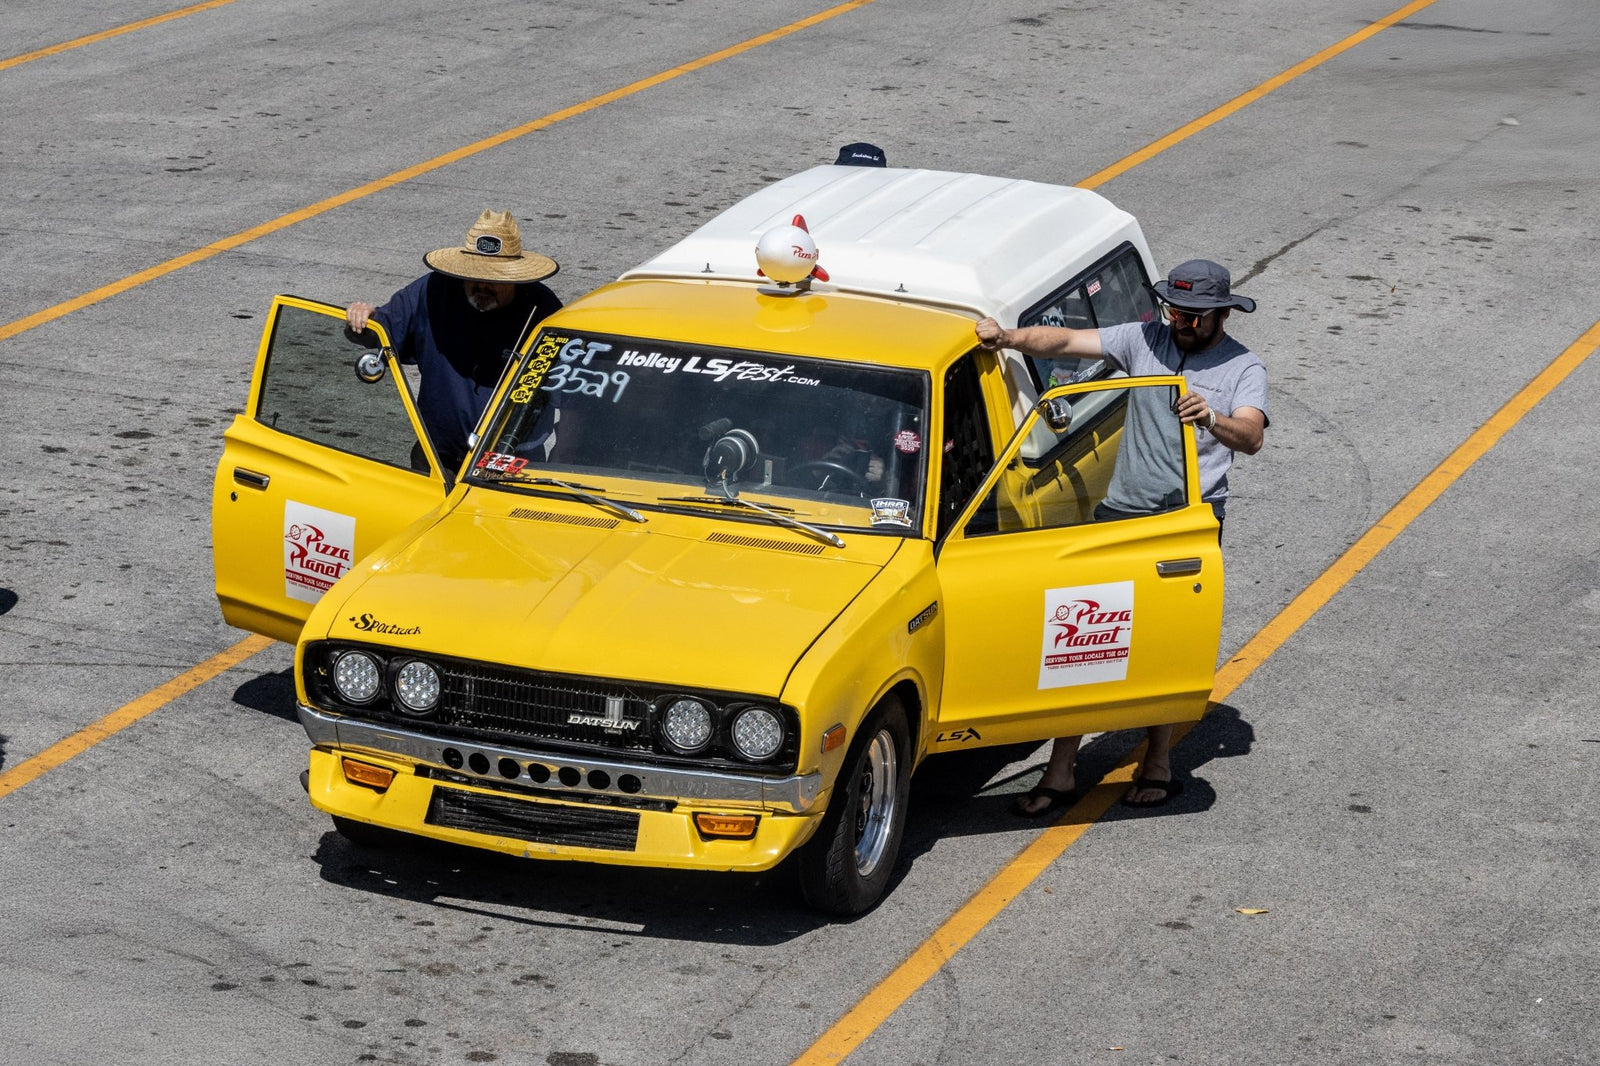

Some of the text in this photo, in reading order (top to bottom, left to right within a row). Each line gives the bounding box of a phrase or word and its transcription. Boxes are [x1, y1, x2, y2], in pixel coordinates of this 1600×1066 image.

[792, 245, 811, 258] Pizza
[559, 338, 612, 365] GT
[616, 350, 682, 373] Holley
[540, 364, 630, 403] 3529
[302, 523, 350, 561] Pizza
[286, 540, 345, 579] Planet
[909, 602, 938, 631] DATSUN
[1072, 600, 1131, 625] Pizza
[1049, 623, 1125, 649] Planet
[1045, 656, 1067, 664] SERVING
[1085, 652, 1104, 660] LOCALS
[567, 715, 640, 730] DATSUN
